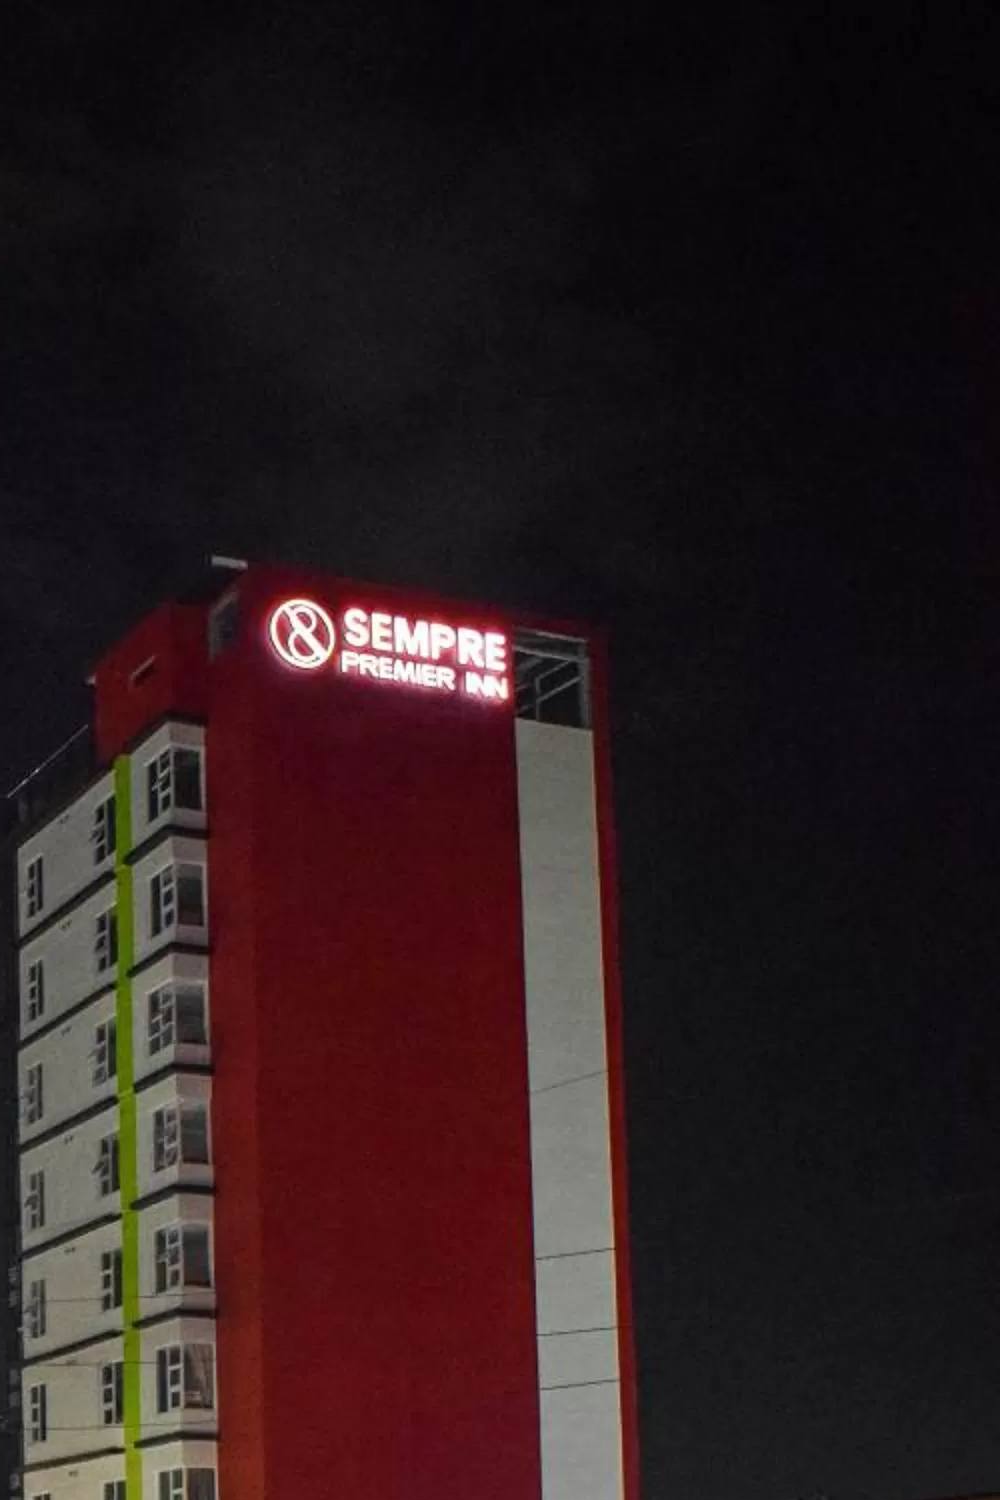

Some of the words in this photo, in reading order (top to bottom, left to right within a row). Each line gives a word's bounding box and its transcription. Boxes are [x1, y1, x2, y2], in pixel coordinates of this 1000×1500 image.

[343, 608, 506, 672] SEMPRE
[340, 650, 456, 690] PREMIER
[465, 671, 508, 699] INN
